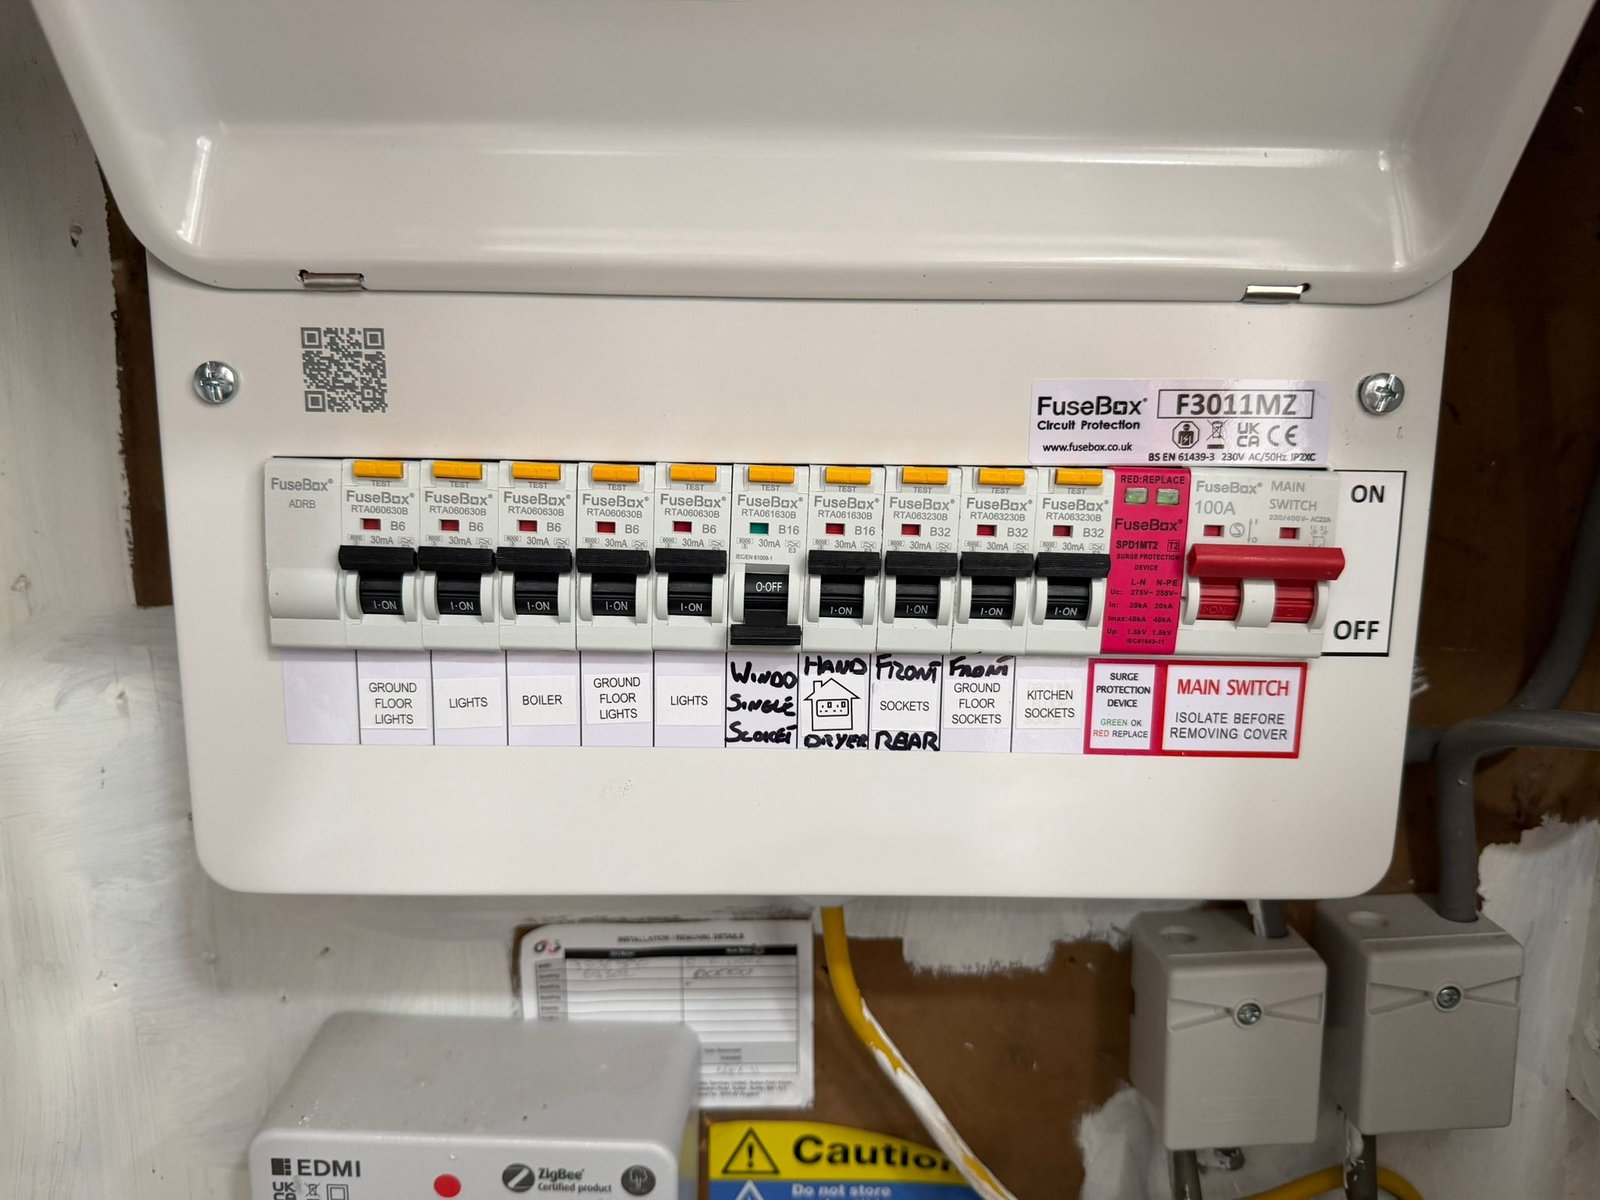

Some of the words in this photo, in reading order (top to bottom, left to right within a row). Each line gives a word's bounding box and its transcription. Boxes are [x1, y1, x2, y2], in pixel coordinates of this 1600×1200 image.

[1176, 393, 1297, 416] F3011MZ
[1038, 420, 1075, 430] Circuit
[1081, 420, 1140, 430] Protection
[1042, 442, 1132, 452] www.fusebox.co.uk
[1148, 453, 1160, 462] BS
[1163, 453, 1176, 462] EN
[1178, 453, 1214, 462] 61439-3
[1222, 453, 1244, 462] 230V
[1249, 453, 1286, 462] AC/50Hz
[1290, 453, 1316, 462] IP2XC
[1120, 475, 1185, 484] RED:REPLACE
[1271, 480, 1305, 492] MAIN
[1351, 484, 1385, 503] ON
[288, 500, 316, 510] ADRB
[1195, 500, 1236, 516] 100A
[1268, 500, 1317, 512] SWITCH
[351, 505, 408, 516] RTA060630B
[430, 506, 487, 516] RTA060630B
[508, 506, 564, 516] RTA060630B
[586, 508, 643, 518] RTA060630B
[664, 508, 720, 518] RTA060630B
[742, 509, 796, 519] RTA061630B
[818, 510, 872, 520] RTA061630B
[893, 511, 948, 521] RTA063230B
[970, 512, 1026, 522] RTA063230B
[1046, 512, 1102, 522] RTA063230B
[390, 521, 406, 531] B6
[468, 522, 484, 532] B6
[546, 522, 562, 532] B6
[624, 525, 640, 534] B6
[702, 524, 717, 534] B6
[778, 525, 800, 534] B16
[854, 526, 876, 536] B16
[930, 527, 951, 536] B32
[1007, 528, 1028, 538] B32
[1082, 528, 1104, 538] B32
[370, 536, 394, 545] 30mA
[448, 536, 472, 546] 30mA
[526, 536, 550, 546] 30mA
[604, 538, 628, 548] 30mA
[682, 538, 704, 548] 30mA
[758, 539, 780, 548] 30mA
[834, 540, 857, 550] 30mA
[910, 540, 932, 550] 30mA
[986, 541, 1009, 550] 30mA
[1116, 541, 1158, 550] SPD1MT2
[1169, 542, 1179, 550] T2
[1062, 542, 1084, 551] 30mA
[1333, 620, 1380, 640] OFF
[804, 656, 868, 675] HAND
[876, 654, 941, 684] FRONT
[1110, 672, 1138, 681] SURGE
[368, 682, 418, 693] GROUND
[594, 677, 641, 688] GROUND
[954, 682, 1000, 692] GROUND
[1177, 678, 1220, 695] MAIN
[1227, 679, 1290, 696] SWITCH
[1027, 690, 1073, 700] KITCHEN
[1096, 686, 1151, 694] PROTECTION
[375, 698, 412, 708] FLOOR
[449, 697, 488, 708] LIGHTS
[522, 694, 562, 706] BOILER
[600, 692, 636, 704] FLOOR
[670, 696, 708, 706] LIGHTS
[959, 698, 995, 708] FLOOR
[1108, 698, 1138, 708] DEVICE
[880, 700, 930, 711] SOCKETS
[600, 708, 638, 720] LIGHTS
[1024, 708, 1075, 718] SOCKETS
[375, 714, 414, 725] LIGHTS
[952, 714, 1002, 724] SOCKETS
[1100, 718, 1128, 726] GREEN
[1175, 712, 1228, 724] ISOLATE
[1234, 713, 1285, 725] BEFORE
[1112, 730, 1148, 738] REPLACE
[1170, 727, 1238, 740] REMOVING
[1244, 728, 1288, 740] COVER
[875, 731, 940, 750] REAR
[298, 1159, 361, 1178] EDMI
[272, 1182, 296, 1192] UK
[538, 1182, 576, 1192] Certified
[578, 1184, 612, 1194] product
[792, 1183, 815, 1197] Do
[818, 1184, 846, 1197] not
[850, 1184, 892, 1197] store
